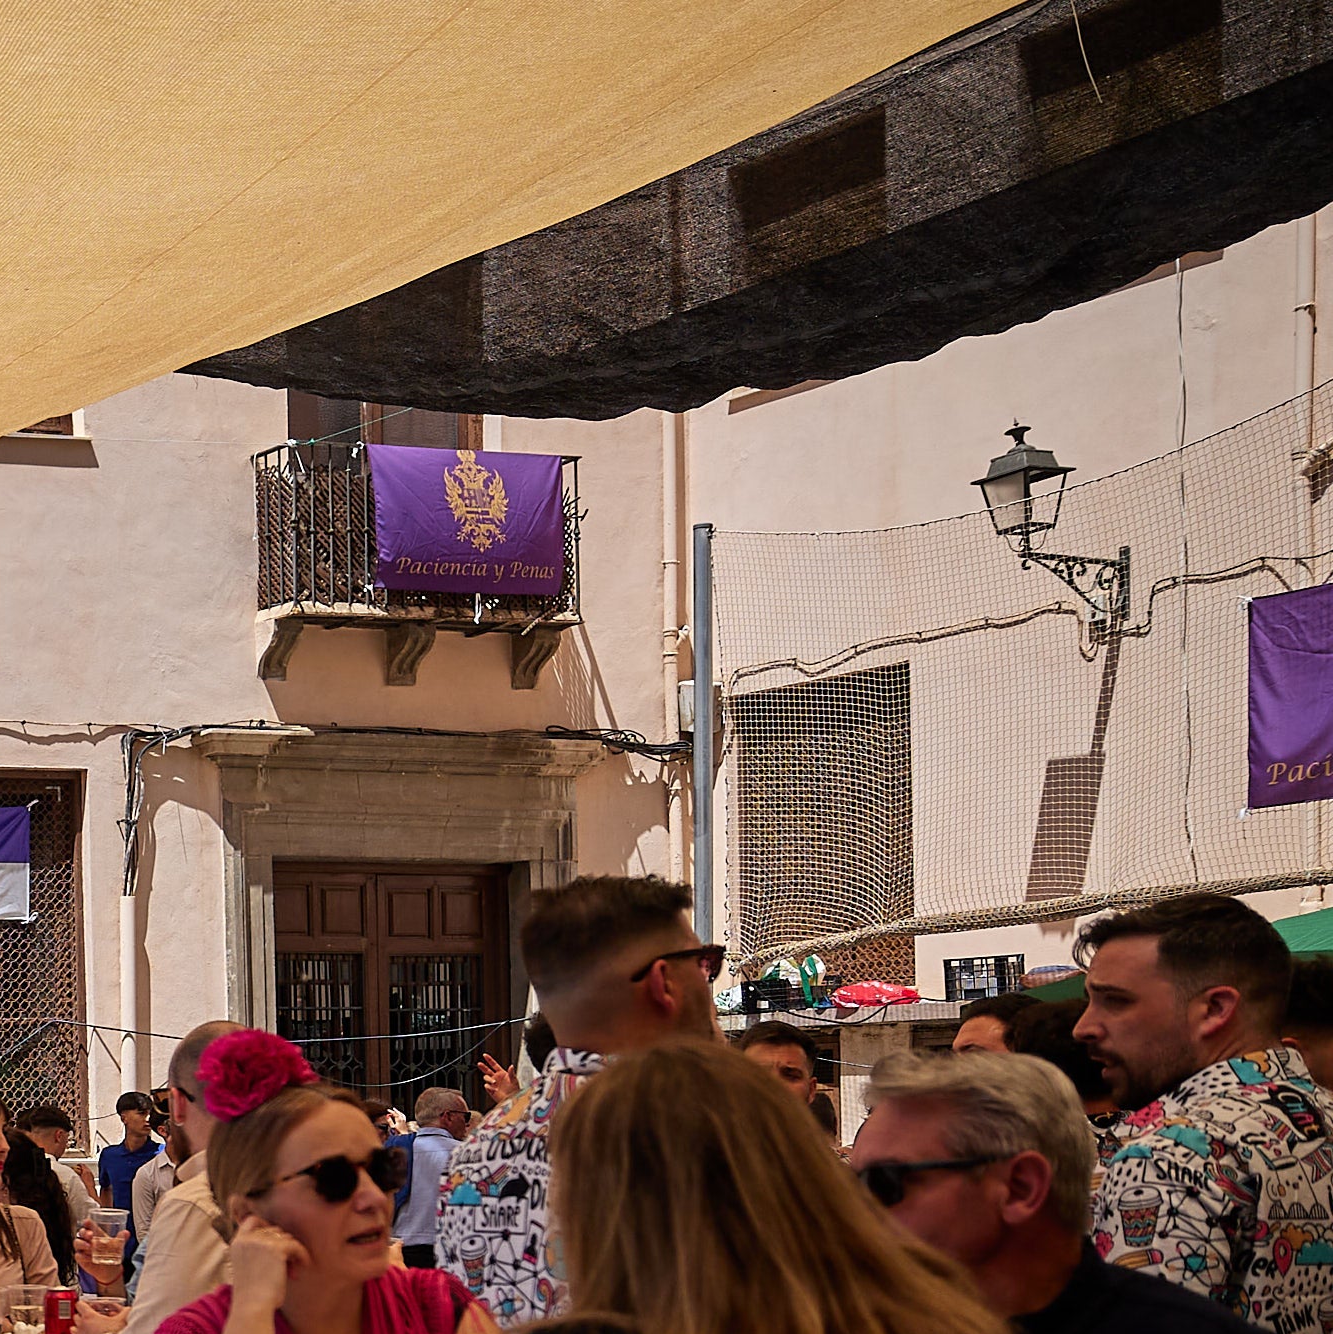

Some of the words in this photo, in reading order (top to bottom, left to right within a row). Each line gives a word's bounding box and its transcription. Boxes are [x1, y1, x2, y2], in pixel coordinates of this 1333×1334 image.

[395, 557, 488, 577] Paciencia
[492, 563, 505, 584] y
[510, 561, 556, 580] Penas
